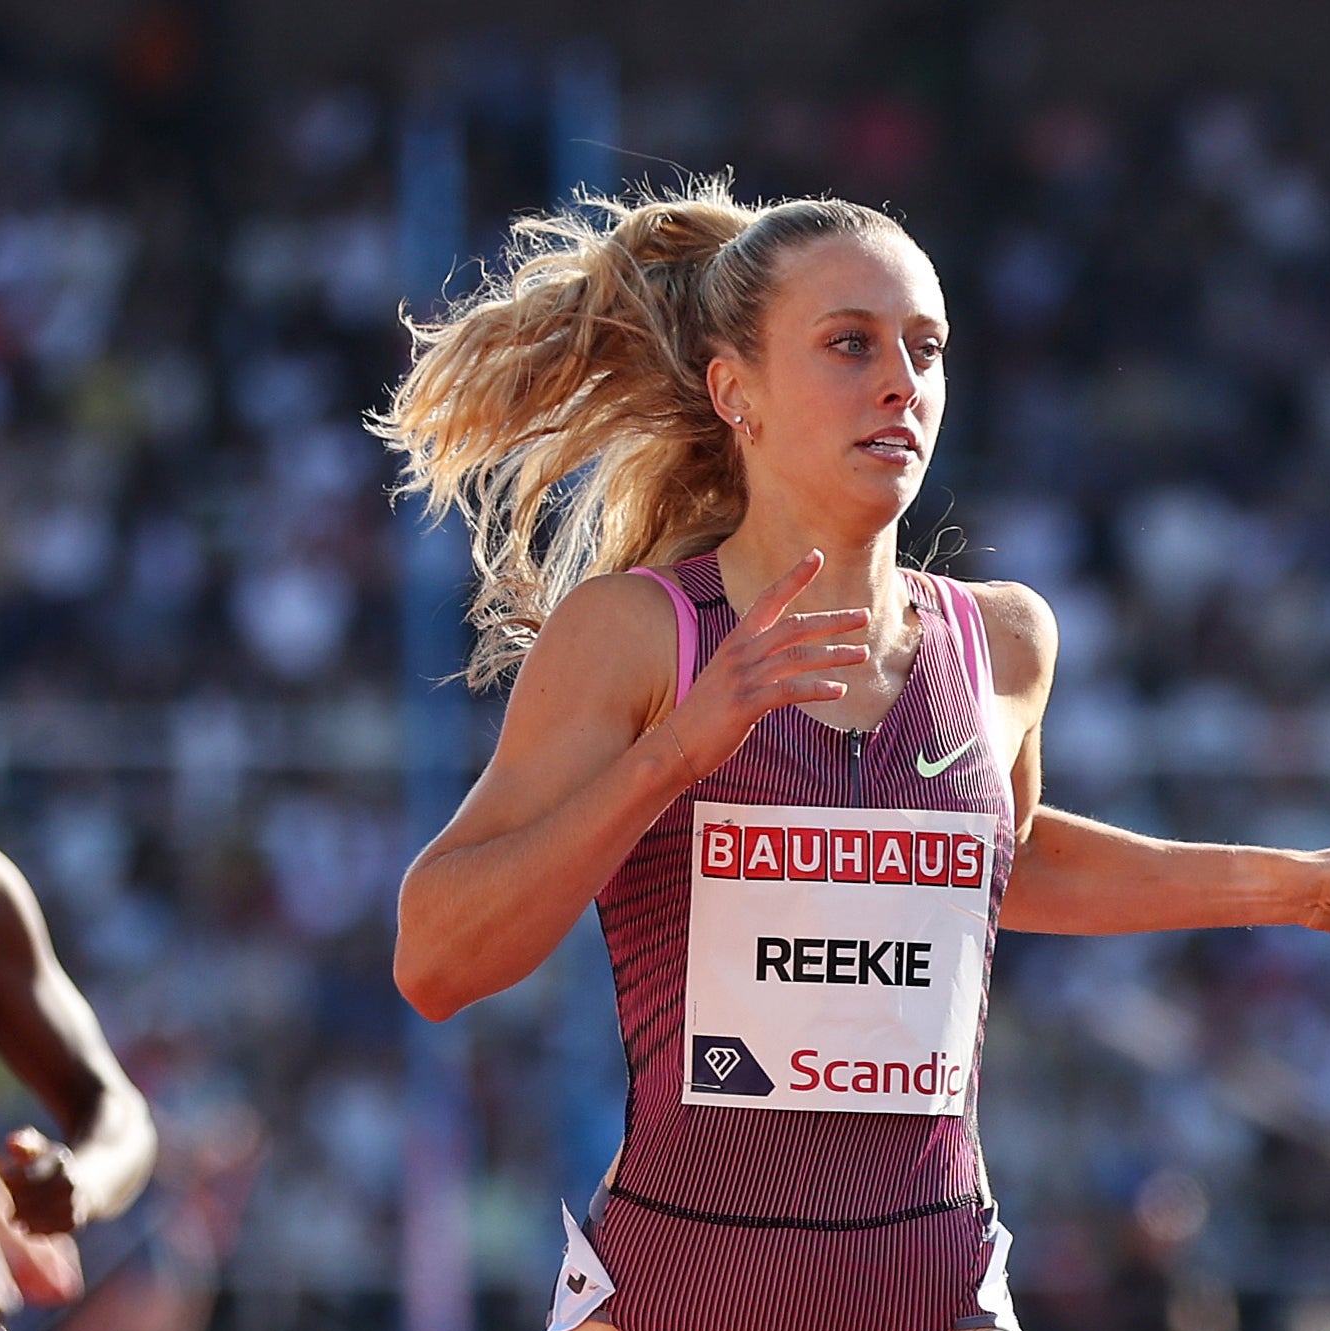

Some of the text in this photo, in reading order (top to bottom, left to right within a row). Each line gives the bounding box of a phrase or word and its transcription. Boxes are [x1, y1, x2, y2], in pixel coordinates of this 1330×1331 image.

[706, 830, 980, 880] BAUHAUS
[756, 937, 932, 988] REEKIE
[789, 1049, 963, 1097] Scandic
